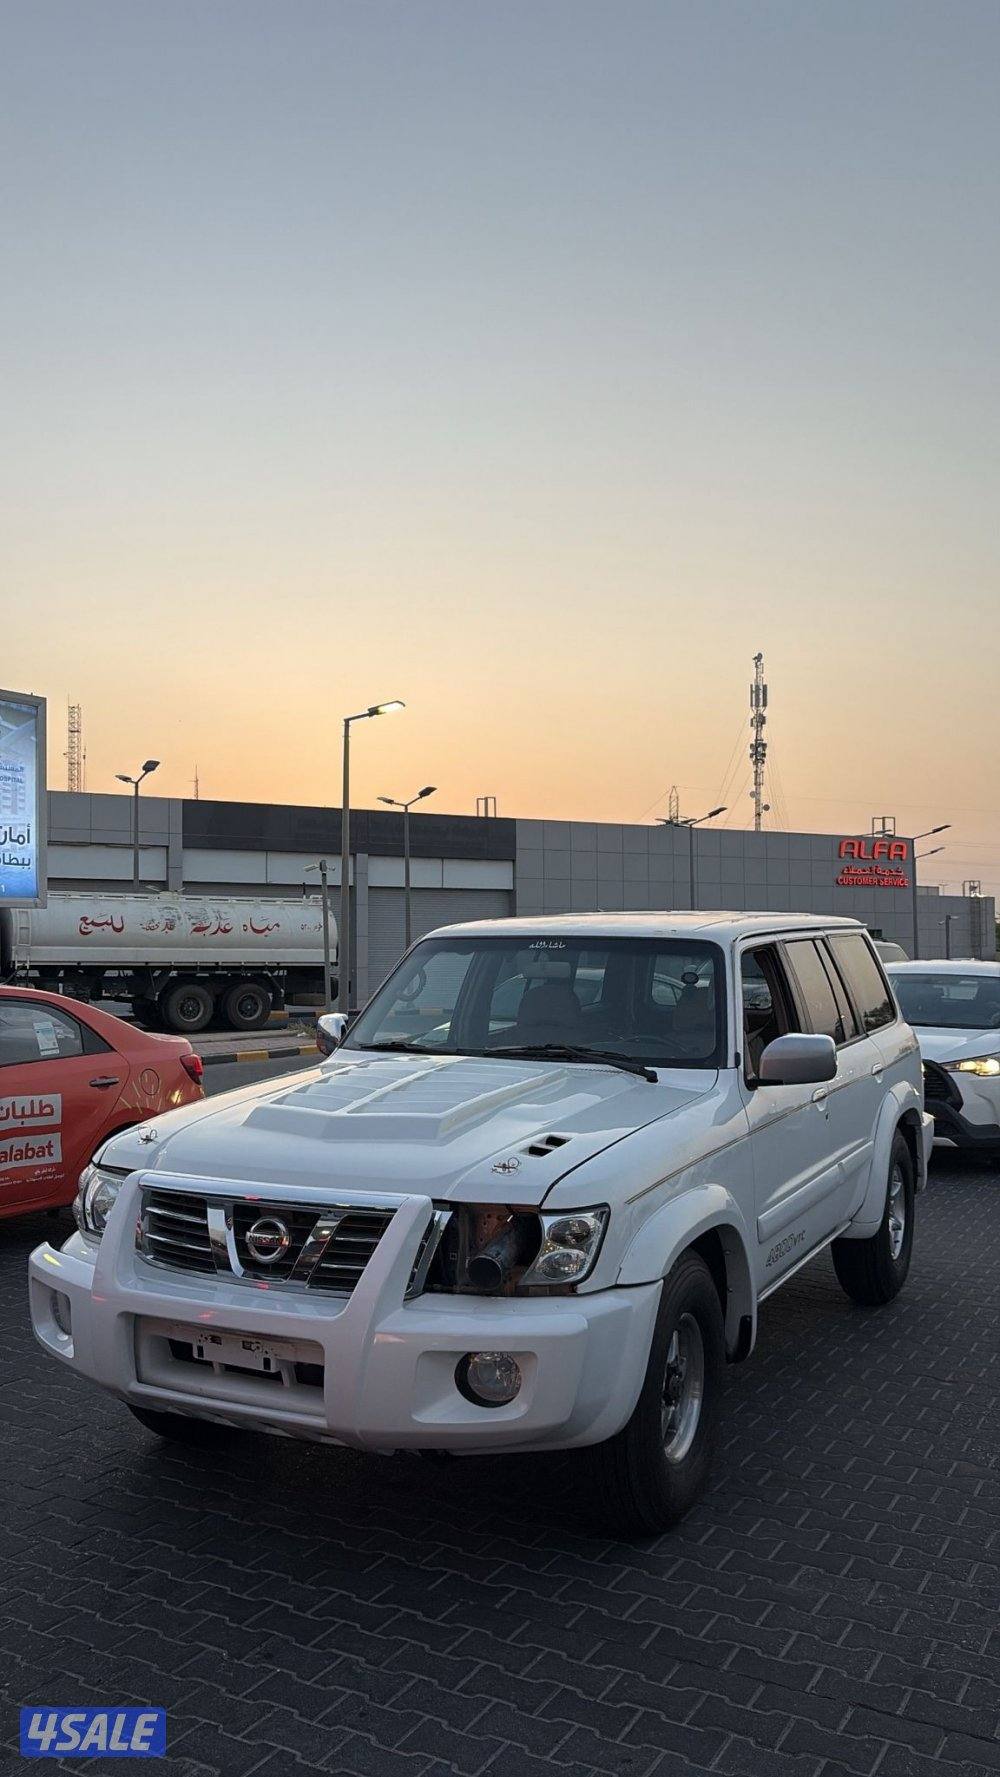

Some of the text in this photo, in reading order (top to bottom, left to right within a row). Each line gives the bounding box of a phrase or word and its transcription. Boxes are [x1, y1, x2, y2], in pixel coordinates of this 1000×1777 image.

[839, 838, 908, 861] ALFA
[0, 852, 31, 870] ببطا
[837, 876, 909, 888] CUSTOMER SERVICE
[79, 911, 125, 937] للبيع
[242, 915, 280, 937] مياه
[0, 1140, 54, 1164] alabat
